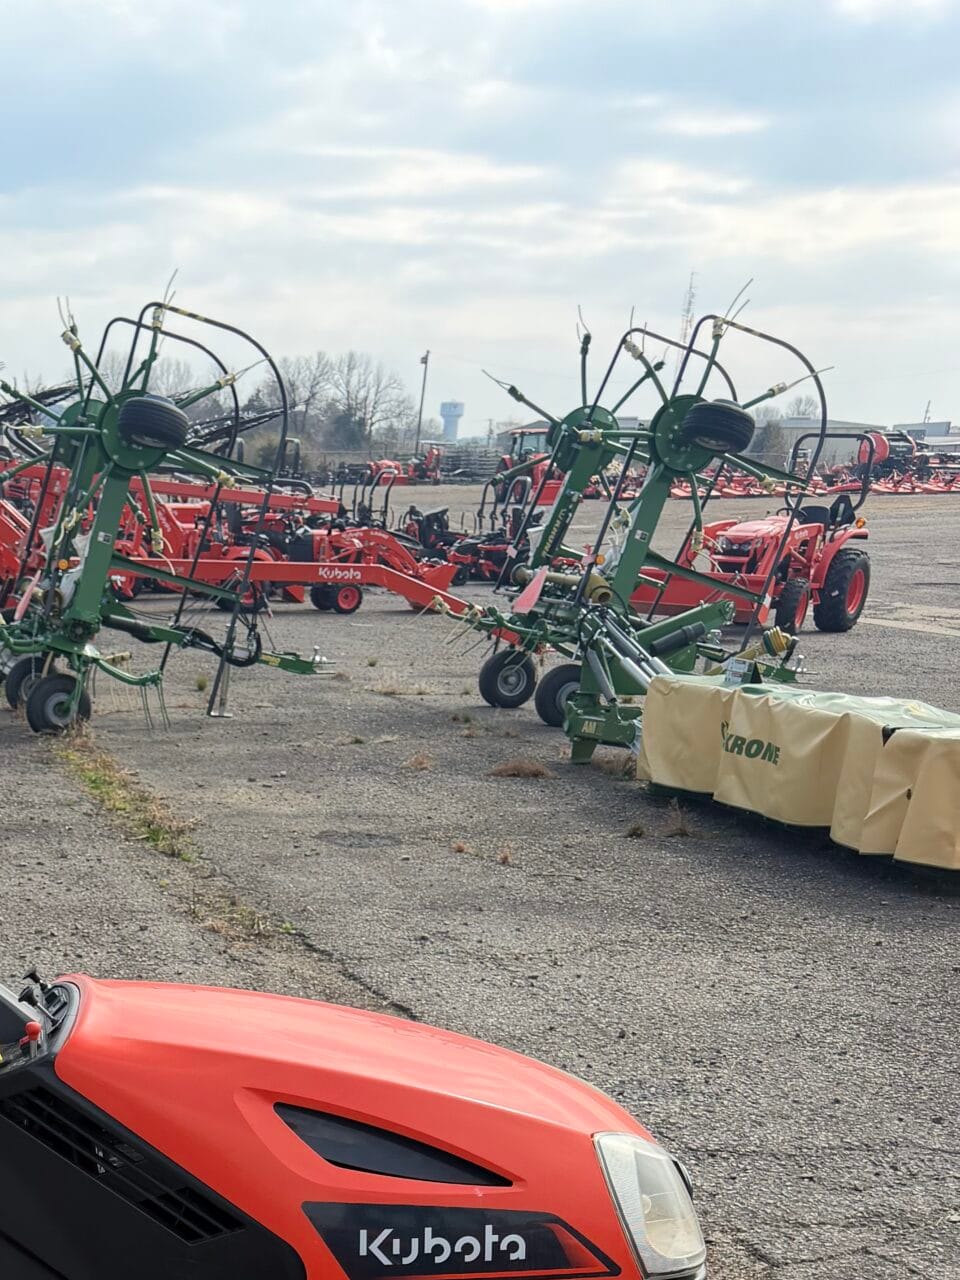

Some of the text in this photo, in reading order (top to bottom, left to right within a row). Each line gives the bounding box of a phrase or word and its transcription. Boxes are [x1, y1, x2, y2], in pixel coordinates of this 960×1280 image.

[318, 567, 362, 580] Kubota
[722, 734, 781, 766] KRONE
[359, 1224, 526, 1266] Kubota
